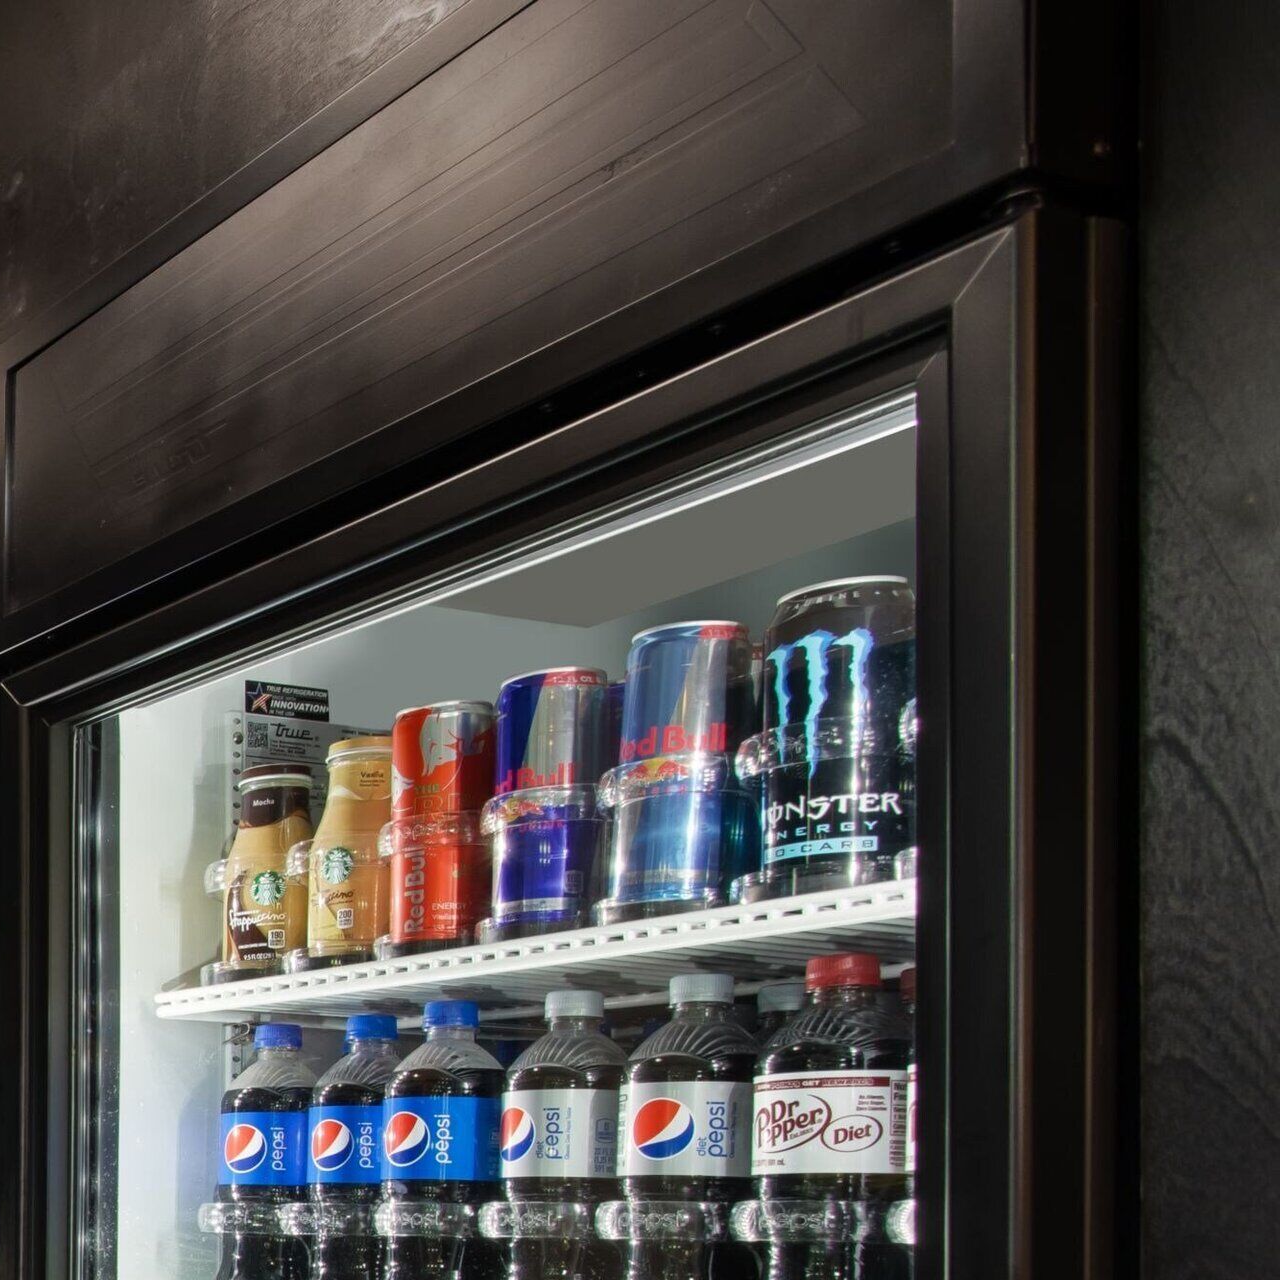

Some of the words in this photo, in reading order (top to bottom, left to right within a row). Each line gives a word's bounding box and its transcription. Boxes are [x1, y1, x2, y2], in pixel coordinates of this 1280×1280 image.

[270, 700, 327, 713] INNOVATION
[662, 722, 727, 753] Bull
[517, 763, 575, 787] Bull
[253, 798, 275, 807] Mocha
[766, 792, 903, 828] ONSTER
[405, 847, 426, 885] Bull
[404, 891, 425, 933] Red
[706, 1100, 729, 1158] pepsi
[770, 1099, 800, 1124] Dr
[271, 1126, 287, 1171] pepsi
[357, 1122, 374, 1169] pepsi
[433, 1114, 453, 1165] pepsi
[543, 1106, 563, 1160] pepsi
[695, 1136, 708, 1157] diet
[833, 1123, 872, 1146] Diet
